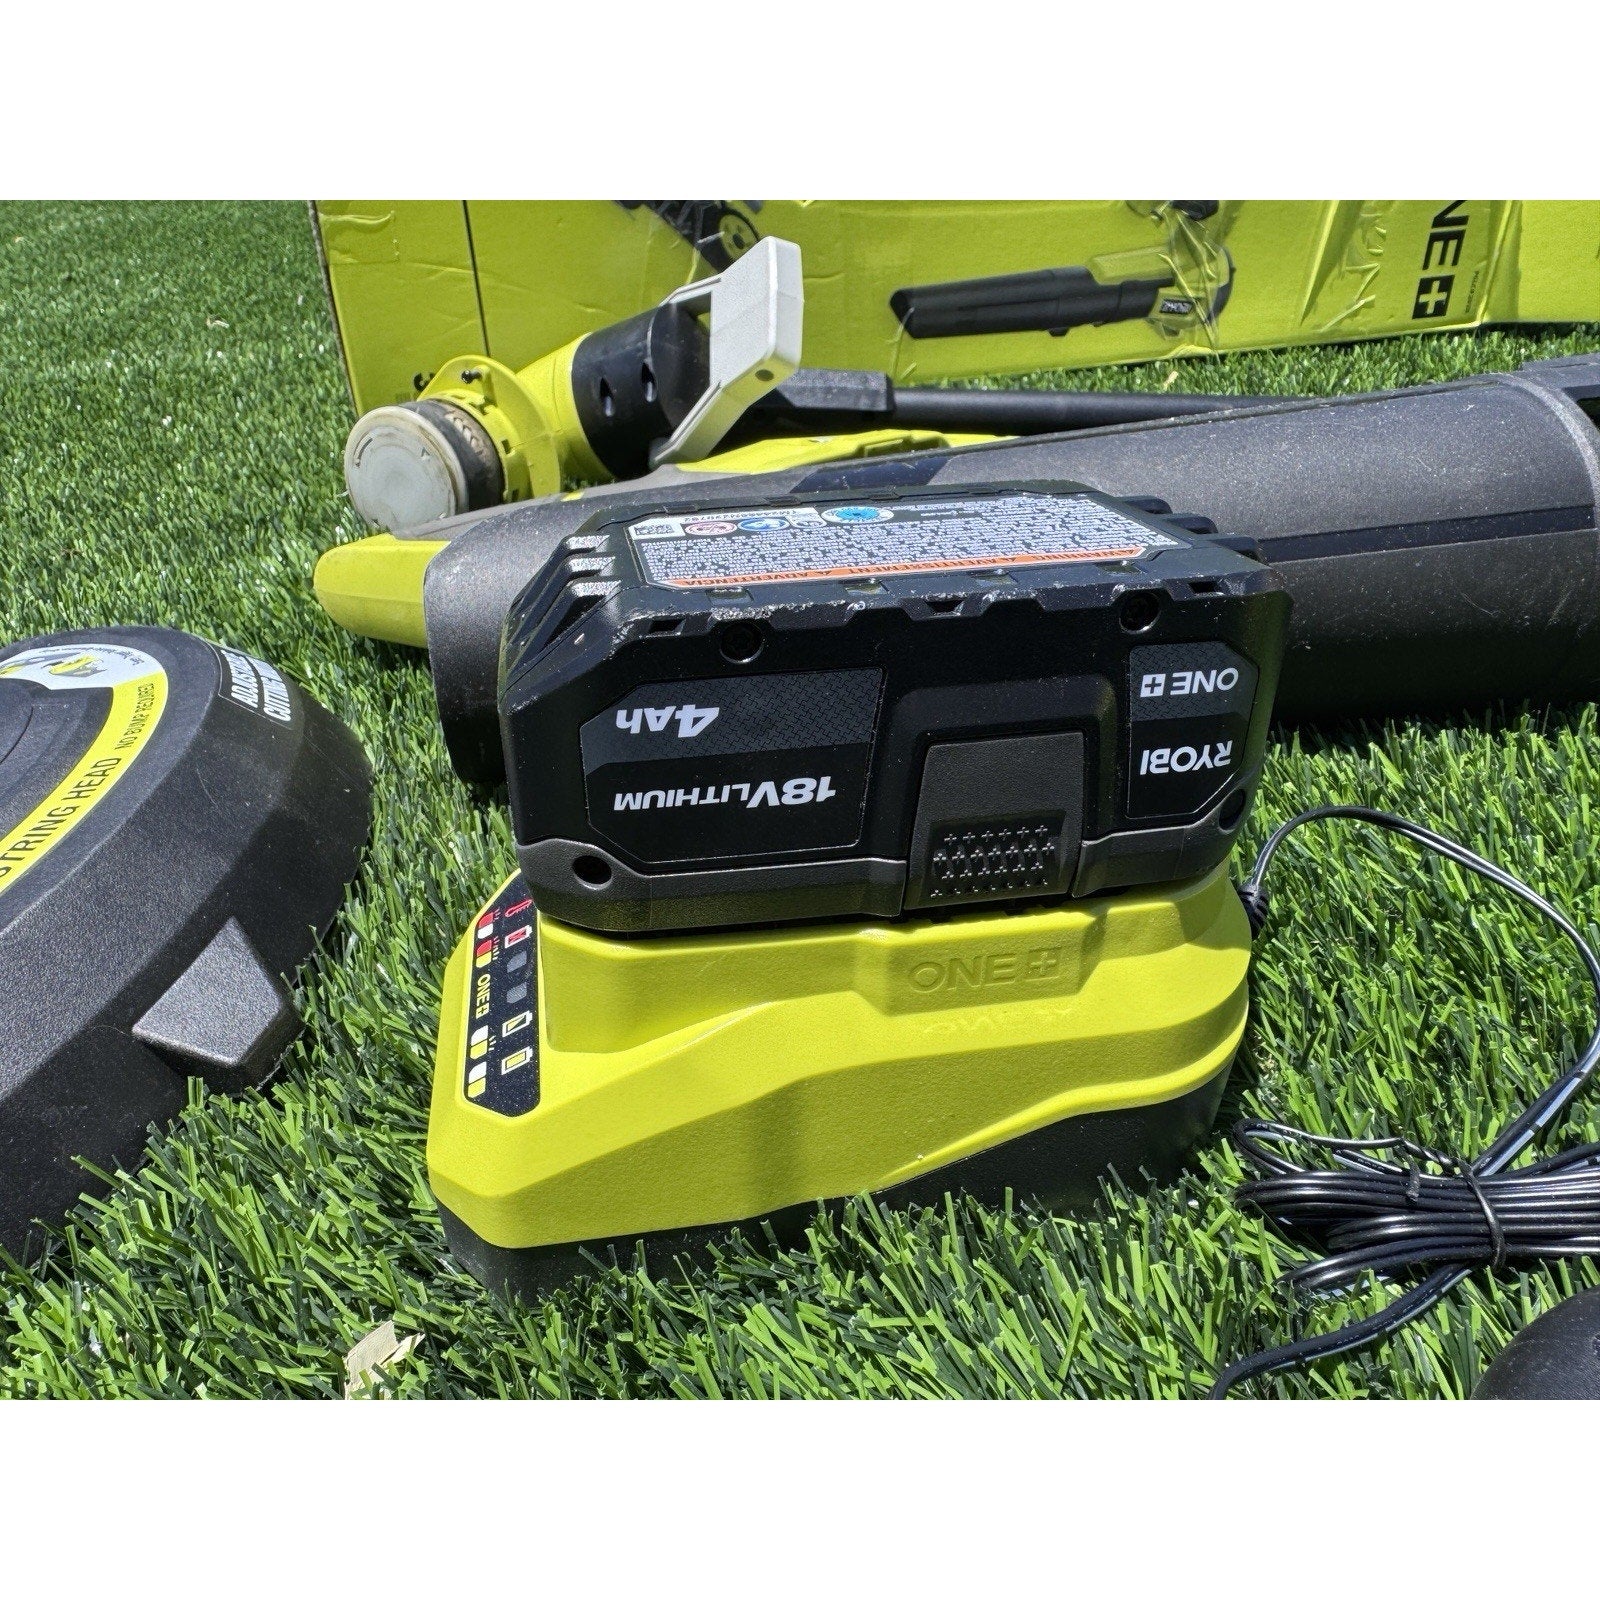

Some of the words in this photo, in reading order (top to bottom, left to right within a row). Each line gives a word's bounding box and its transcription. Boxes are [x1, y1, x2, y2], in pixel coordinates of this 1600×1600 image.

[615, 704, 720, 738] 4Ah
[61, 758, 122, 801] HEAD
[114, 736, 138, 750] NO
[1140, 740, 1233, 775] RYOBI
